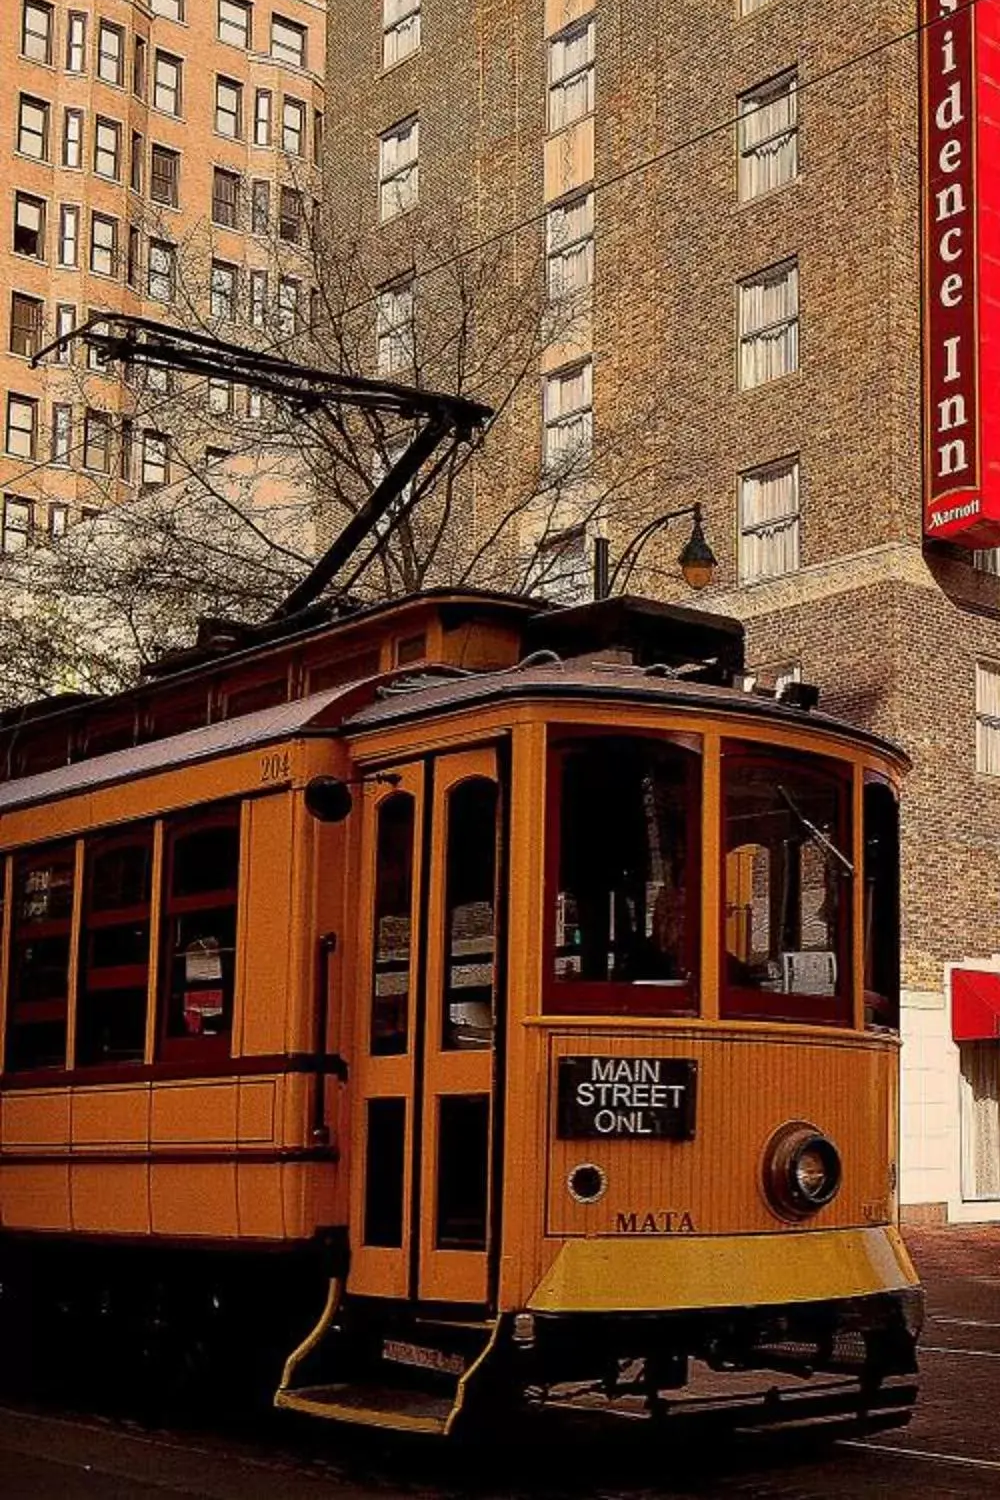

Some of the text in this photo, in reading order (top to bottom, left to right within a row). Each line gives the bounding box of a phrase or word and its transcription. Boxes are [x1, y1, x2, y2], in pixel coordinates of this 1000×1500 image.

[937, 335, 969, 477] Inn
[928, 499, 980, 531] Marriott
[261, 750, 290, 781] 204
[591, 1058, 661, 1083] MAIN
[576, 1082, 686, 1108] STREET
[616, 1211, 697, 1233] MATA
